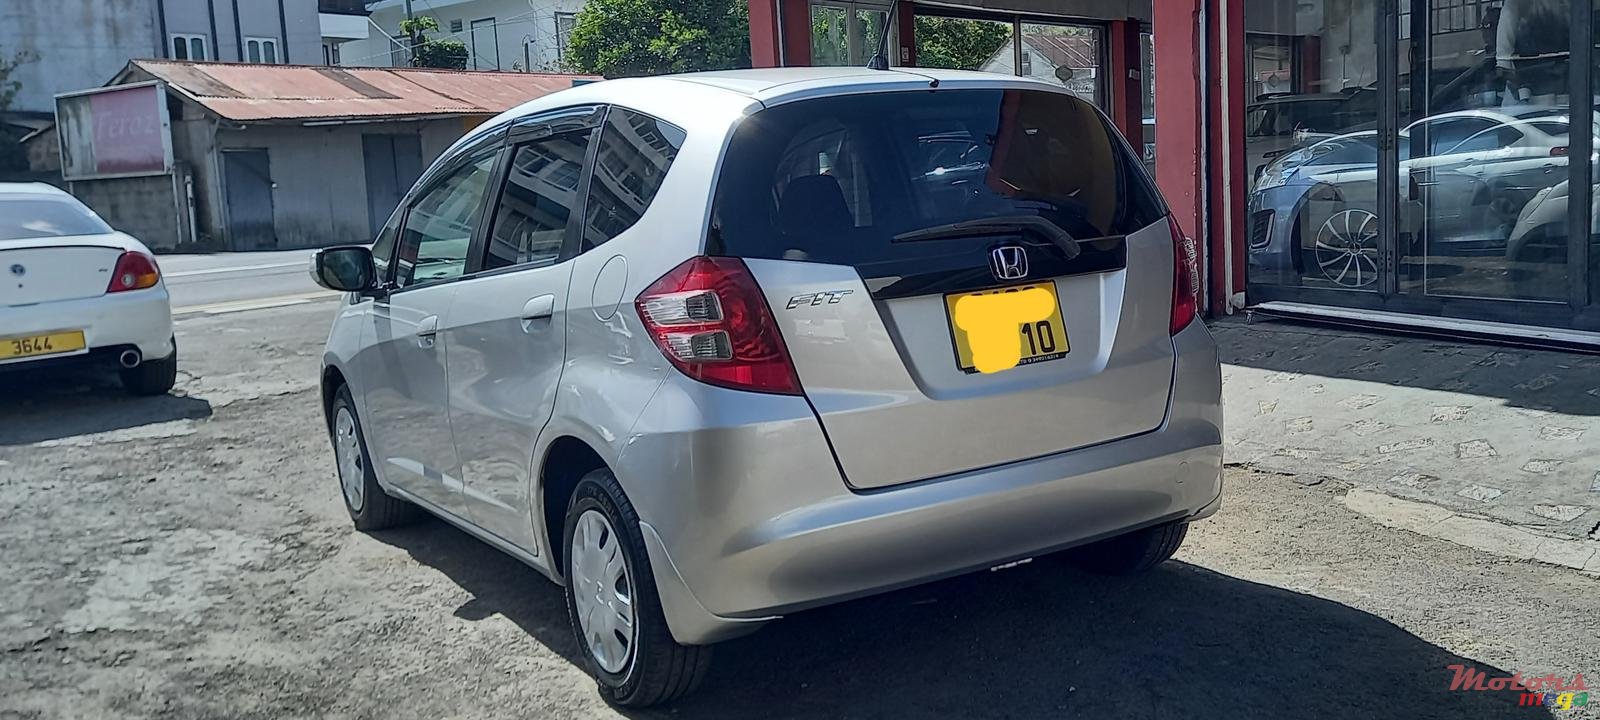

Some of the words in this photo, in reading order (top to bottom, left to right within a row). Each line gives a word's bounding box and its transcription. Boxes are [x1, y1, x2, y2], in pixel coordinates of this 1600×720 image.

[786, 289, 854, 310] FIT
[11, 337, 53, 355] 3644
[1021, 320, 1056, 355] 10
